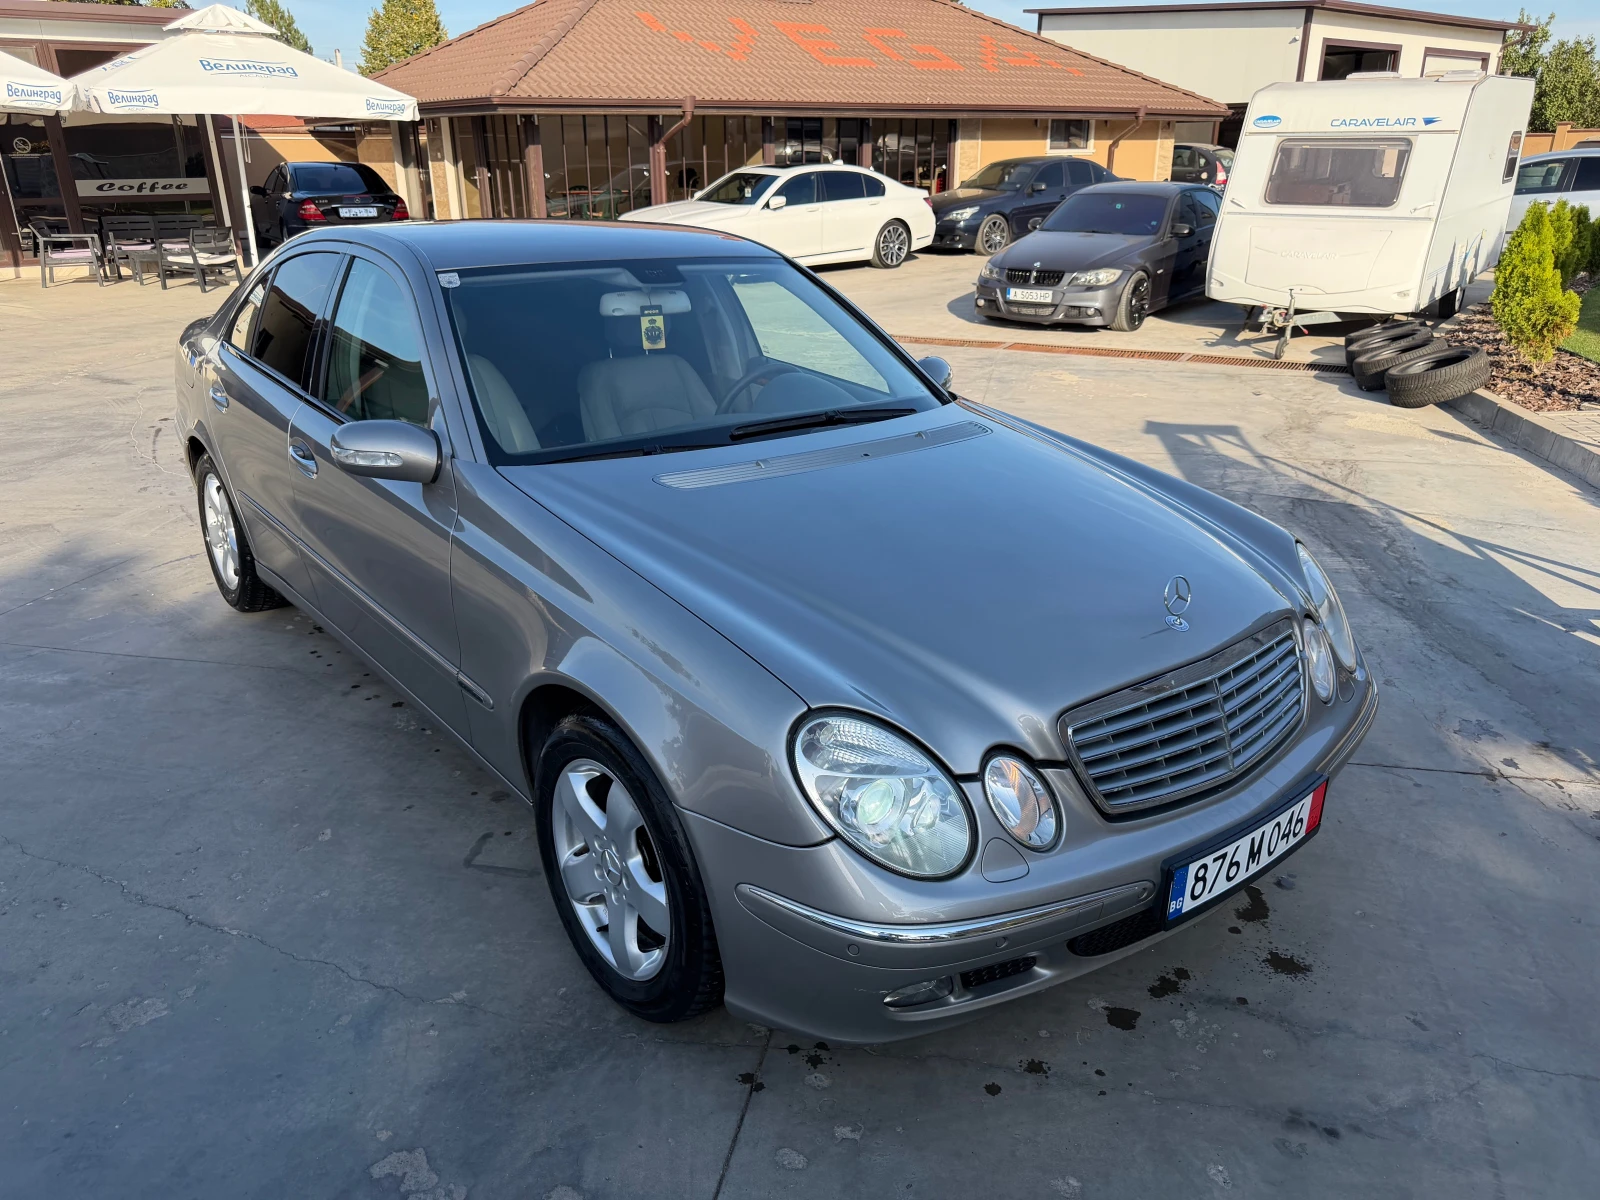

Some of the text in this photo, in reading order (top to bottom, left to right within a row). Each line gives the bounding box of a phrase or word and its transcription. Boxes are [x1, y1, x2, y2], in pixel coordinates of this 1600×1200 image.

[635, 11, 1085, 76] VEGA
[199, 59, 298, 77] Велинград
[7, 84, 61, 103] Велинград
[107, 91, 159, 107] Велинград
[366, 99, 405, 114] Велинград
[1330, 117, 1416, 127] CARAVELAIR
[96, 182, 188, 193] Coffee
[1280, 250, 1337, 260] CARAVELAIR
[1021, 291, 1039, 300] 5053
[1189, 802, 1306, 901] 876 M 046
[1170, 897, 1183, 912] BG
